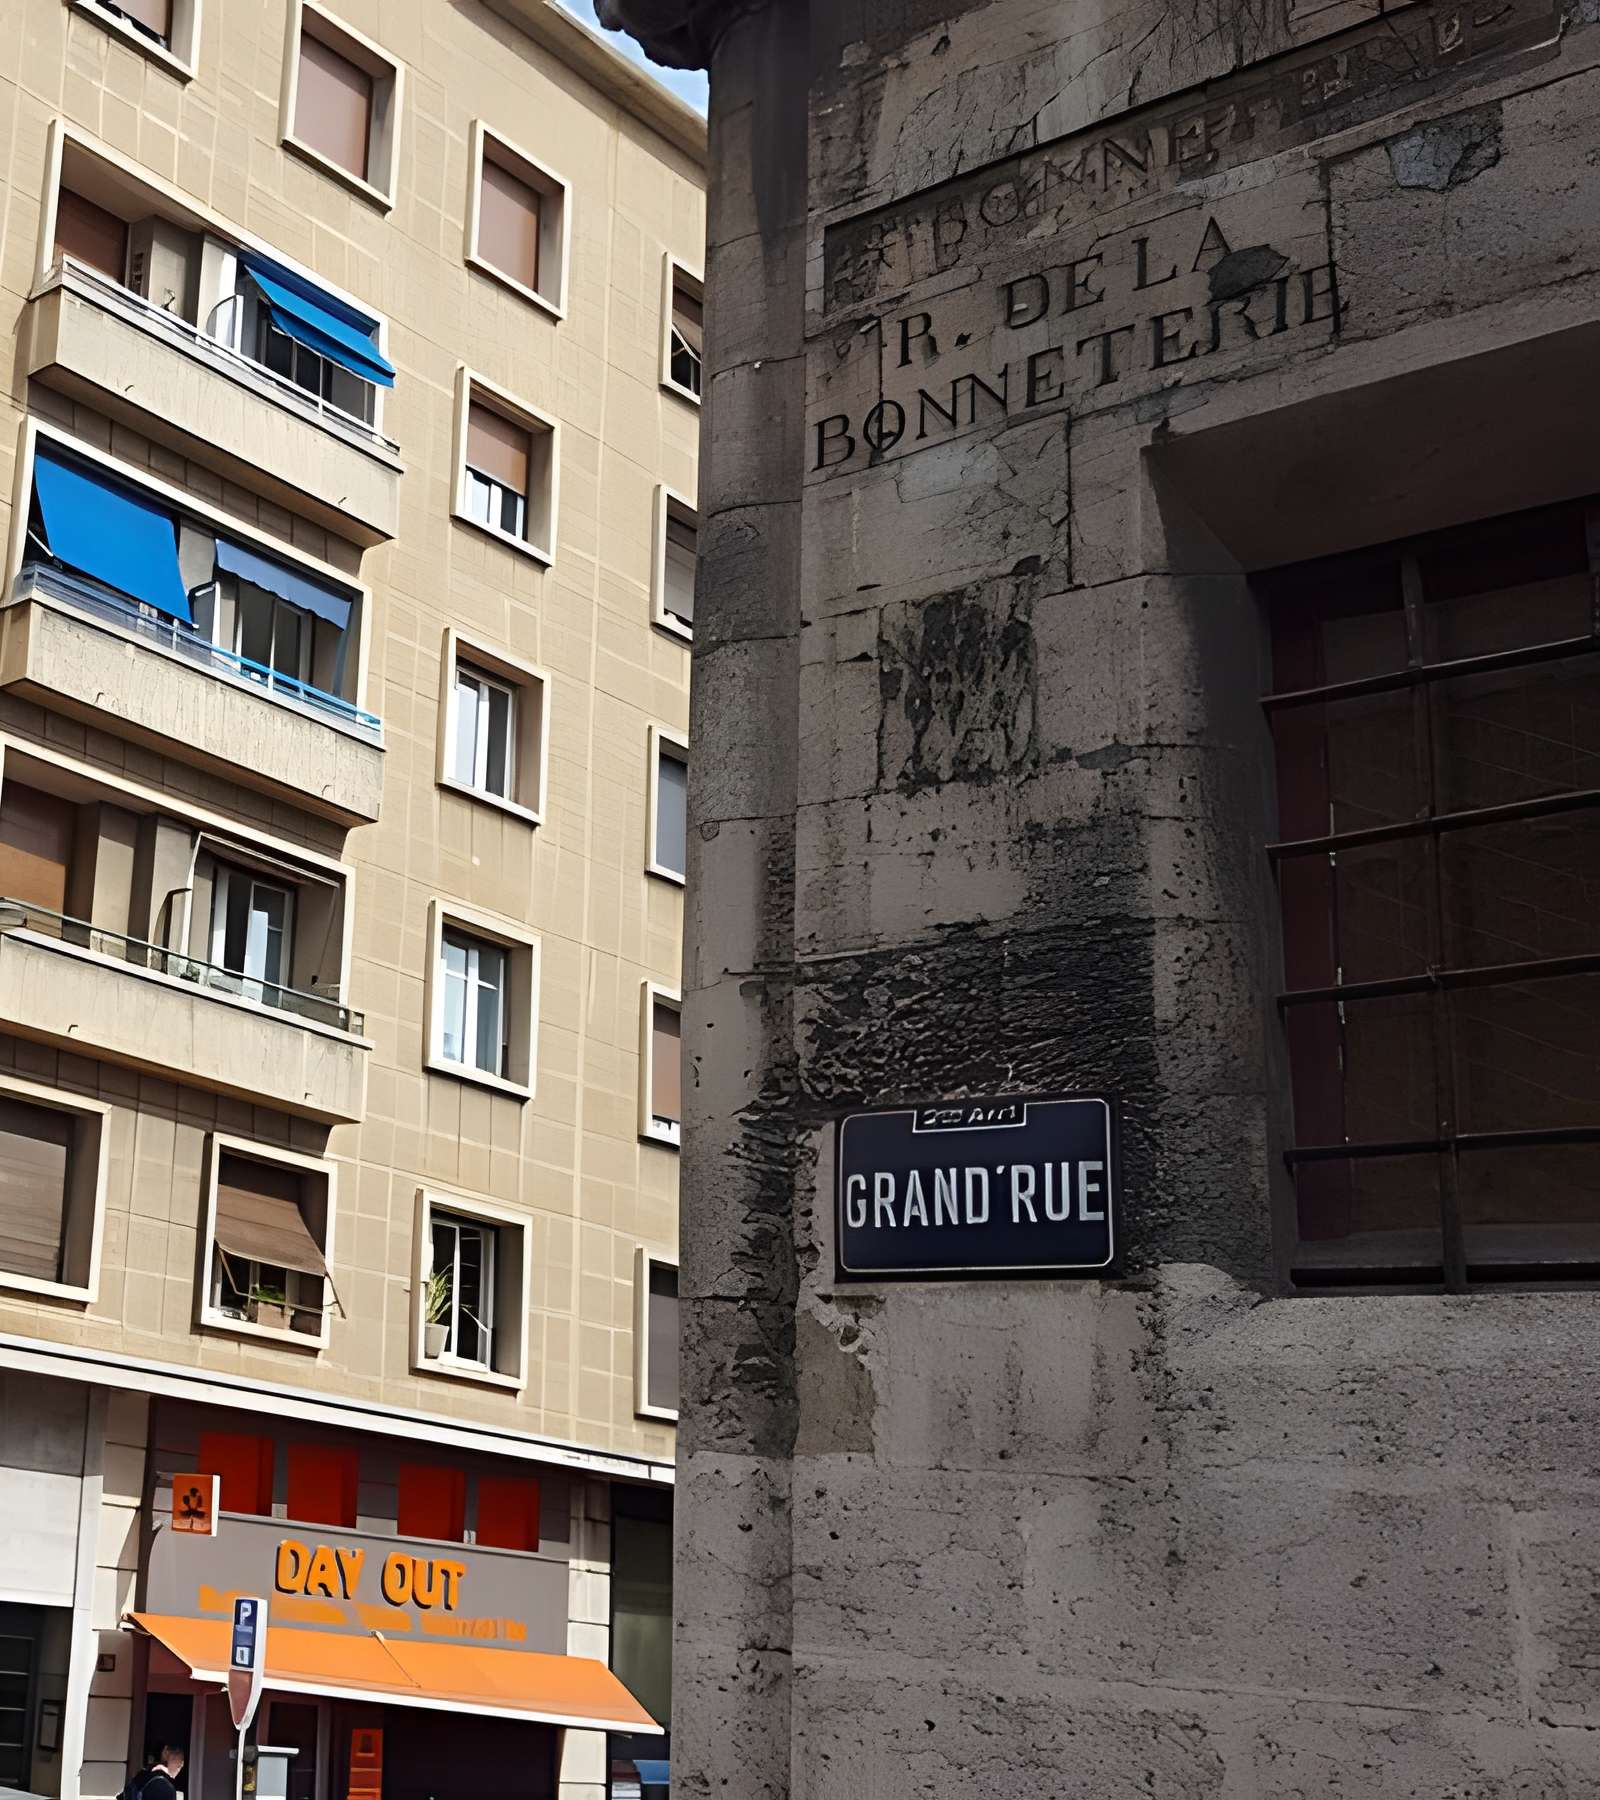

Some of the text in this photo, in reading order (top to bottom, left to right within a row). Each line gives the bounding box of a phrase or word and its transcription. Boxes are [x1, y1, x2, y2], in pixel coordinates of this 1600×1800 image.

[999, 252, 1105, 330] DE
[1131, 216, 1233, 291] LA
[846, 1160, 1105, 1228] GRAND'RUE
[275, 1539, 467, 1611] DAY OUT
